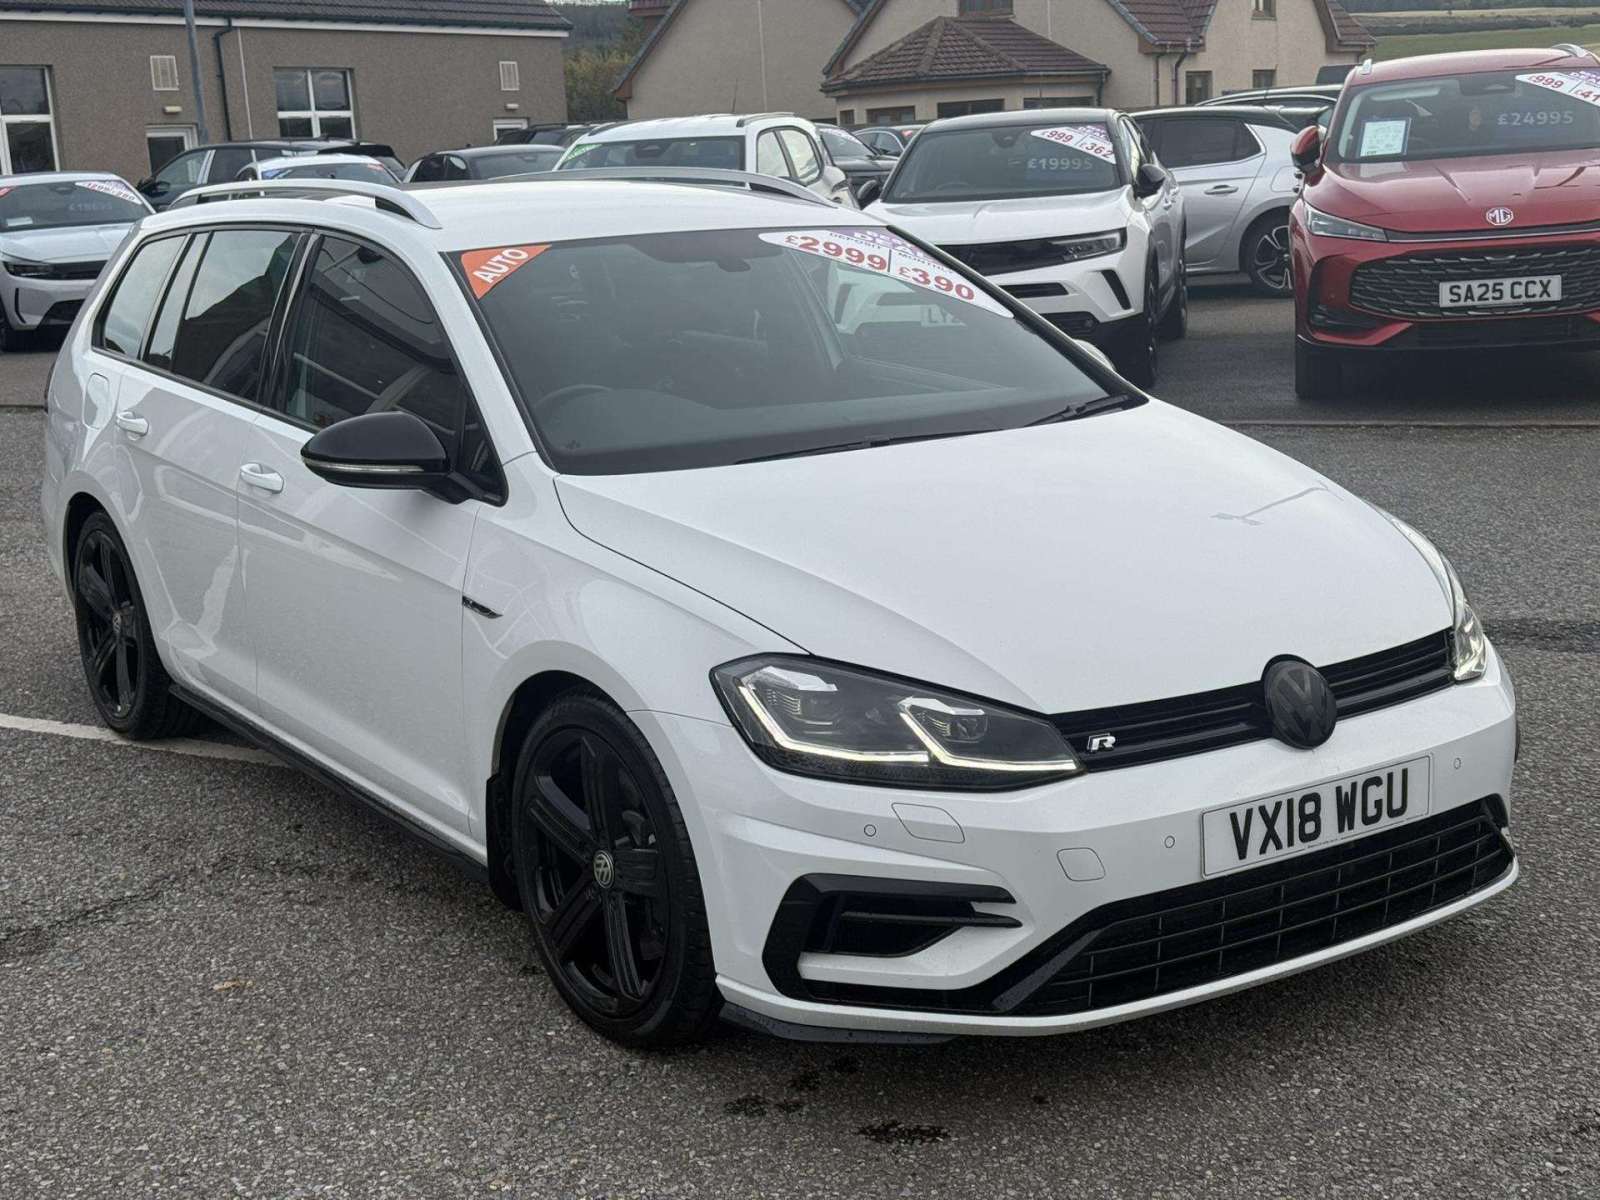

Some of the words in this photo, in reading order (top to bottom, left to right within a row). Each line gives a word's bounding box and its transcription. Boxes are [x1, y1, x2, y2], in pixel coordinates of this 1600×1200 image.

[1497, 111, 1574, 126] £24995
[1027, 157, 1094, 171] £19995
[1487, 208, 1512, 225] MG
[785, 234, 888, 271] £2999
[472, 248, 529, 284] AUTO
[898, 265, 976, 301] £390
[1449, 282, 1504, 303] SA25
[1510, 279, 1551, 300] CCX
[1087, 732, 1116, 752] R
[1229, 791, 1323, 861] VX18
[1335, 767, 1409, 835] WGU
